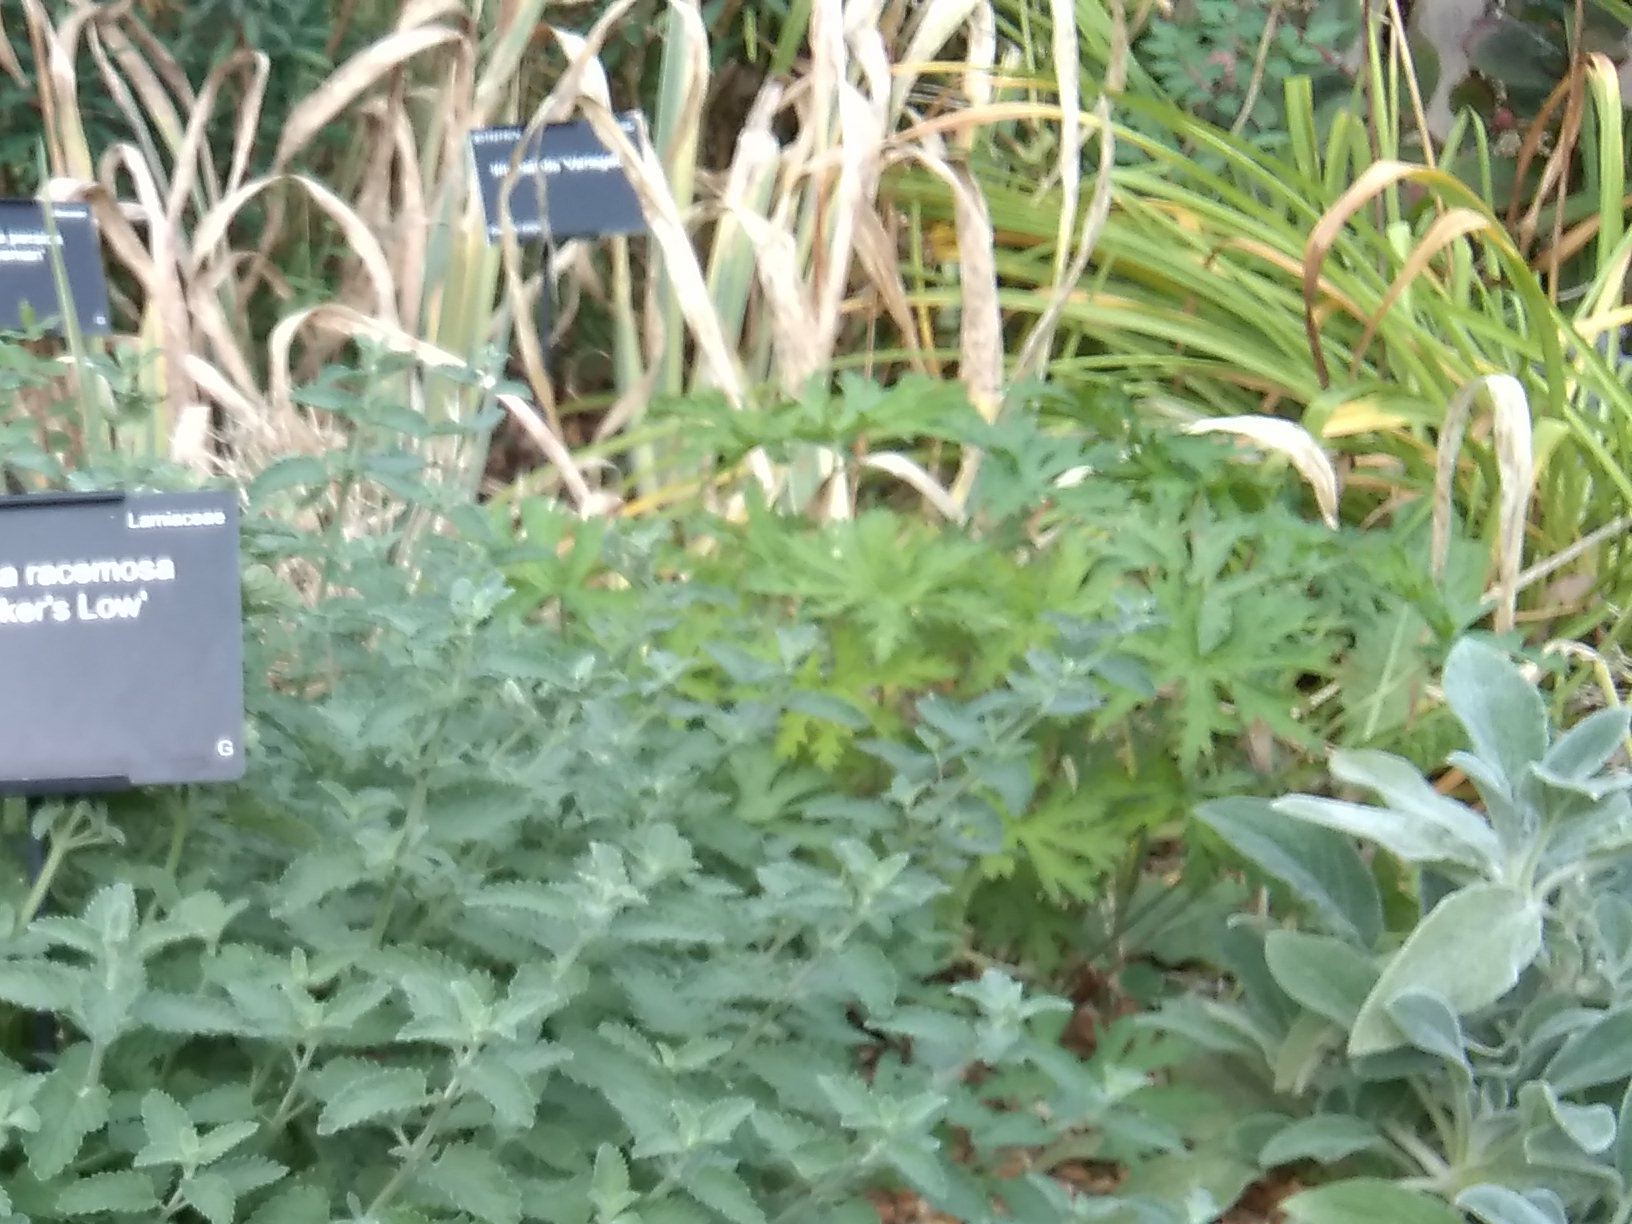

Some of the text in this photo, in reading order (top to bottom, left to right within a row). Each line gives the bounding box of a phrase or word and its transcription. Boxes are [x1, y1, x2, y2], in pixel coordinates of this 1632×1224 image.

[128, 510, 226, 529] Lamiaceae
[26, 556, 175, 586] racemosa
[78, 590, 148, 620] Low'
[217, 738, 234, 757] G
